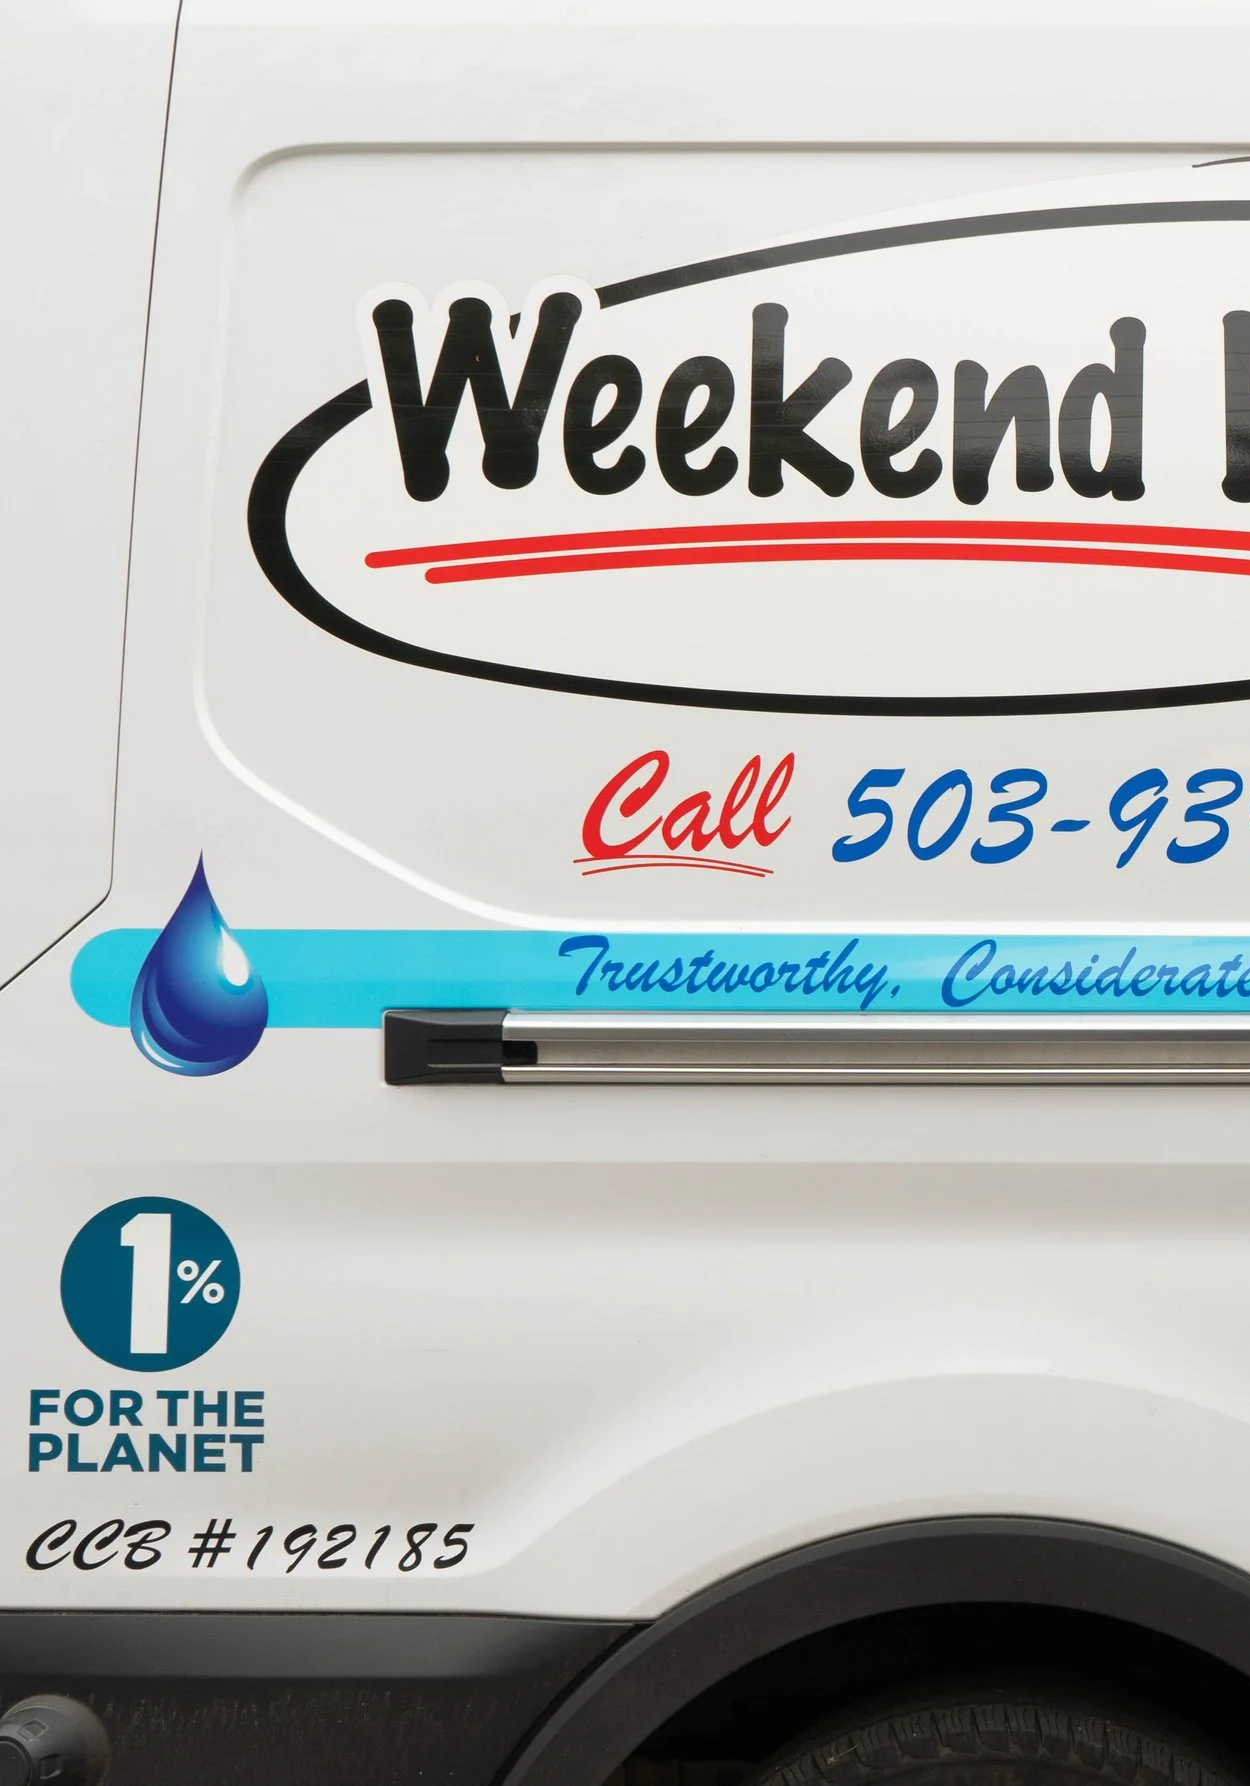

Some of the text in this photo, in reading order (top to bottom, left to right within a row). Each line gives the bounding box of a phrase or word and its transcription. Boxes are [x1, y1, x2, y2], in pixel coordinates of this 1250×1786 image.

[372, 291, 1147, 505] Weekend
[577, 749, 795, 865] Call
[558, 934, 901, 1010] Trustworthy,
[119, 1212, 226, 1355] 1%
[29, 1388, 266, 1427] FOR THE
[28, 1433, 264, 1473] PLANET
[25, 1517, 476, 1574] CCB #192185
